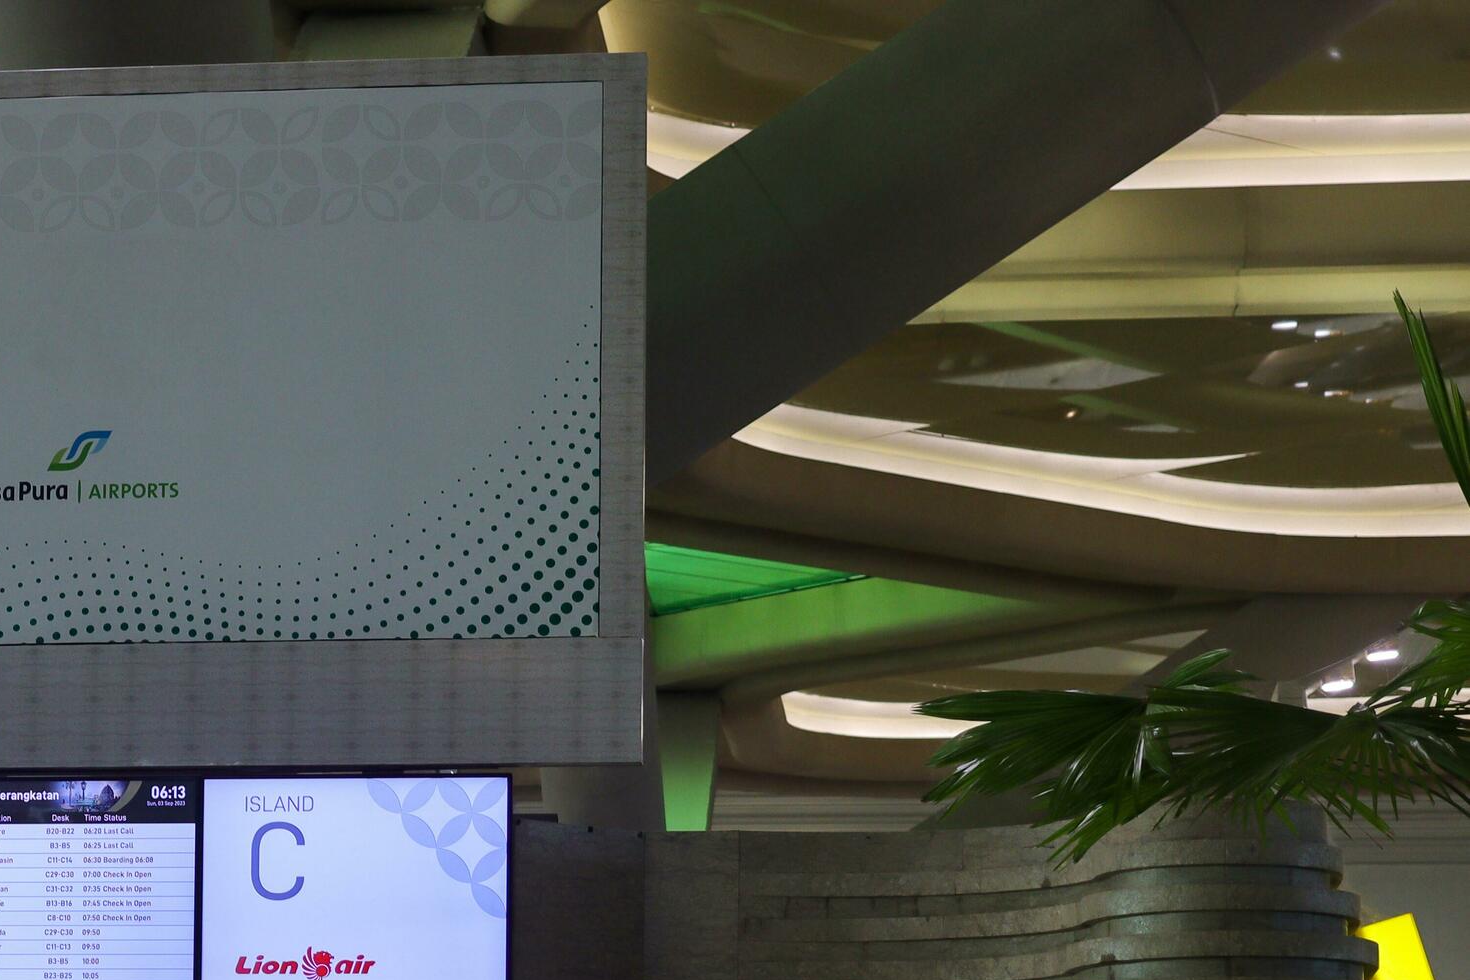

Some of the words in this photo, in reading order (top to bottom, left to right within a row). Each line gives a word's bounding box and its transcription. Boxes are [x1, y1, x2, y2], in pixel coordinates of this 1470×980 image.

[89, 482, 179, 499] AIRPORTS
[151, 786, 186, 799] 06:13
[244, 796, 314, 812] ISLAND
[52, 814, 69, 822] Desk
[84, 814, 101, 822] Time
[104, 814, 126, 822] Status
[250, 821, 305, 900] C
[235, 955, 298, 975] Lion
[334, 954, 376, 975] air
